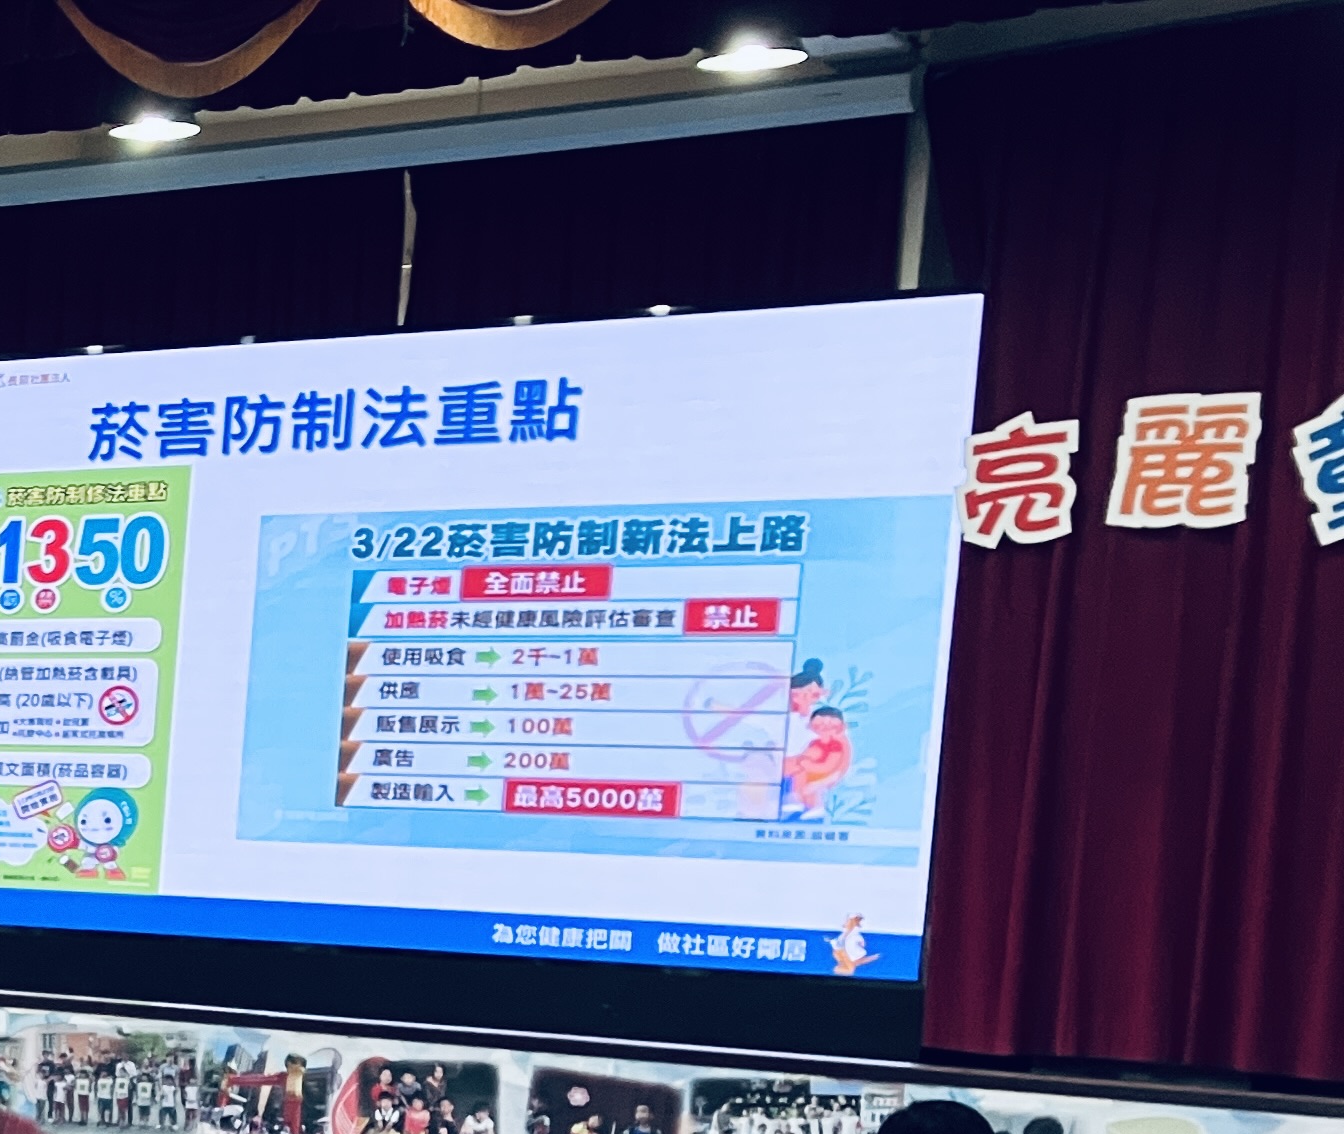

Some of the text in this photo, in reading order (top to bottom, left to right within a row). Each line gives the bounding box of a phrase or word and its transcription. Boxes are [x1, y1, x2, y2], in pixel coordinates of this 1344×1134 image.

[87, 376, 583, 462] 菸害防制法重點
[5, 480, 168, 508] 菸害防制修法重點
[351, 514, 806, 560] 3/22菸害防制新法上路
[484, 571, 587, 595] 全面禁止
[702, 604, 759, 629] 禁止
[381, 647, 467, 668] 使用吸食
[509, 717, 574, 737] 100萬
[372, 749, 570, 771] 廣告 200萬
[514, 785, 665, 813] 最高5000萬
